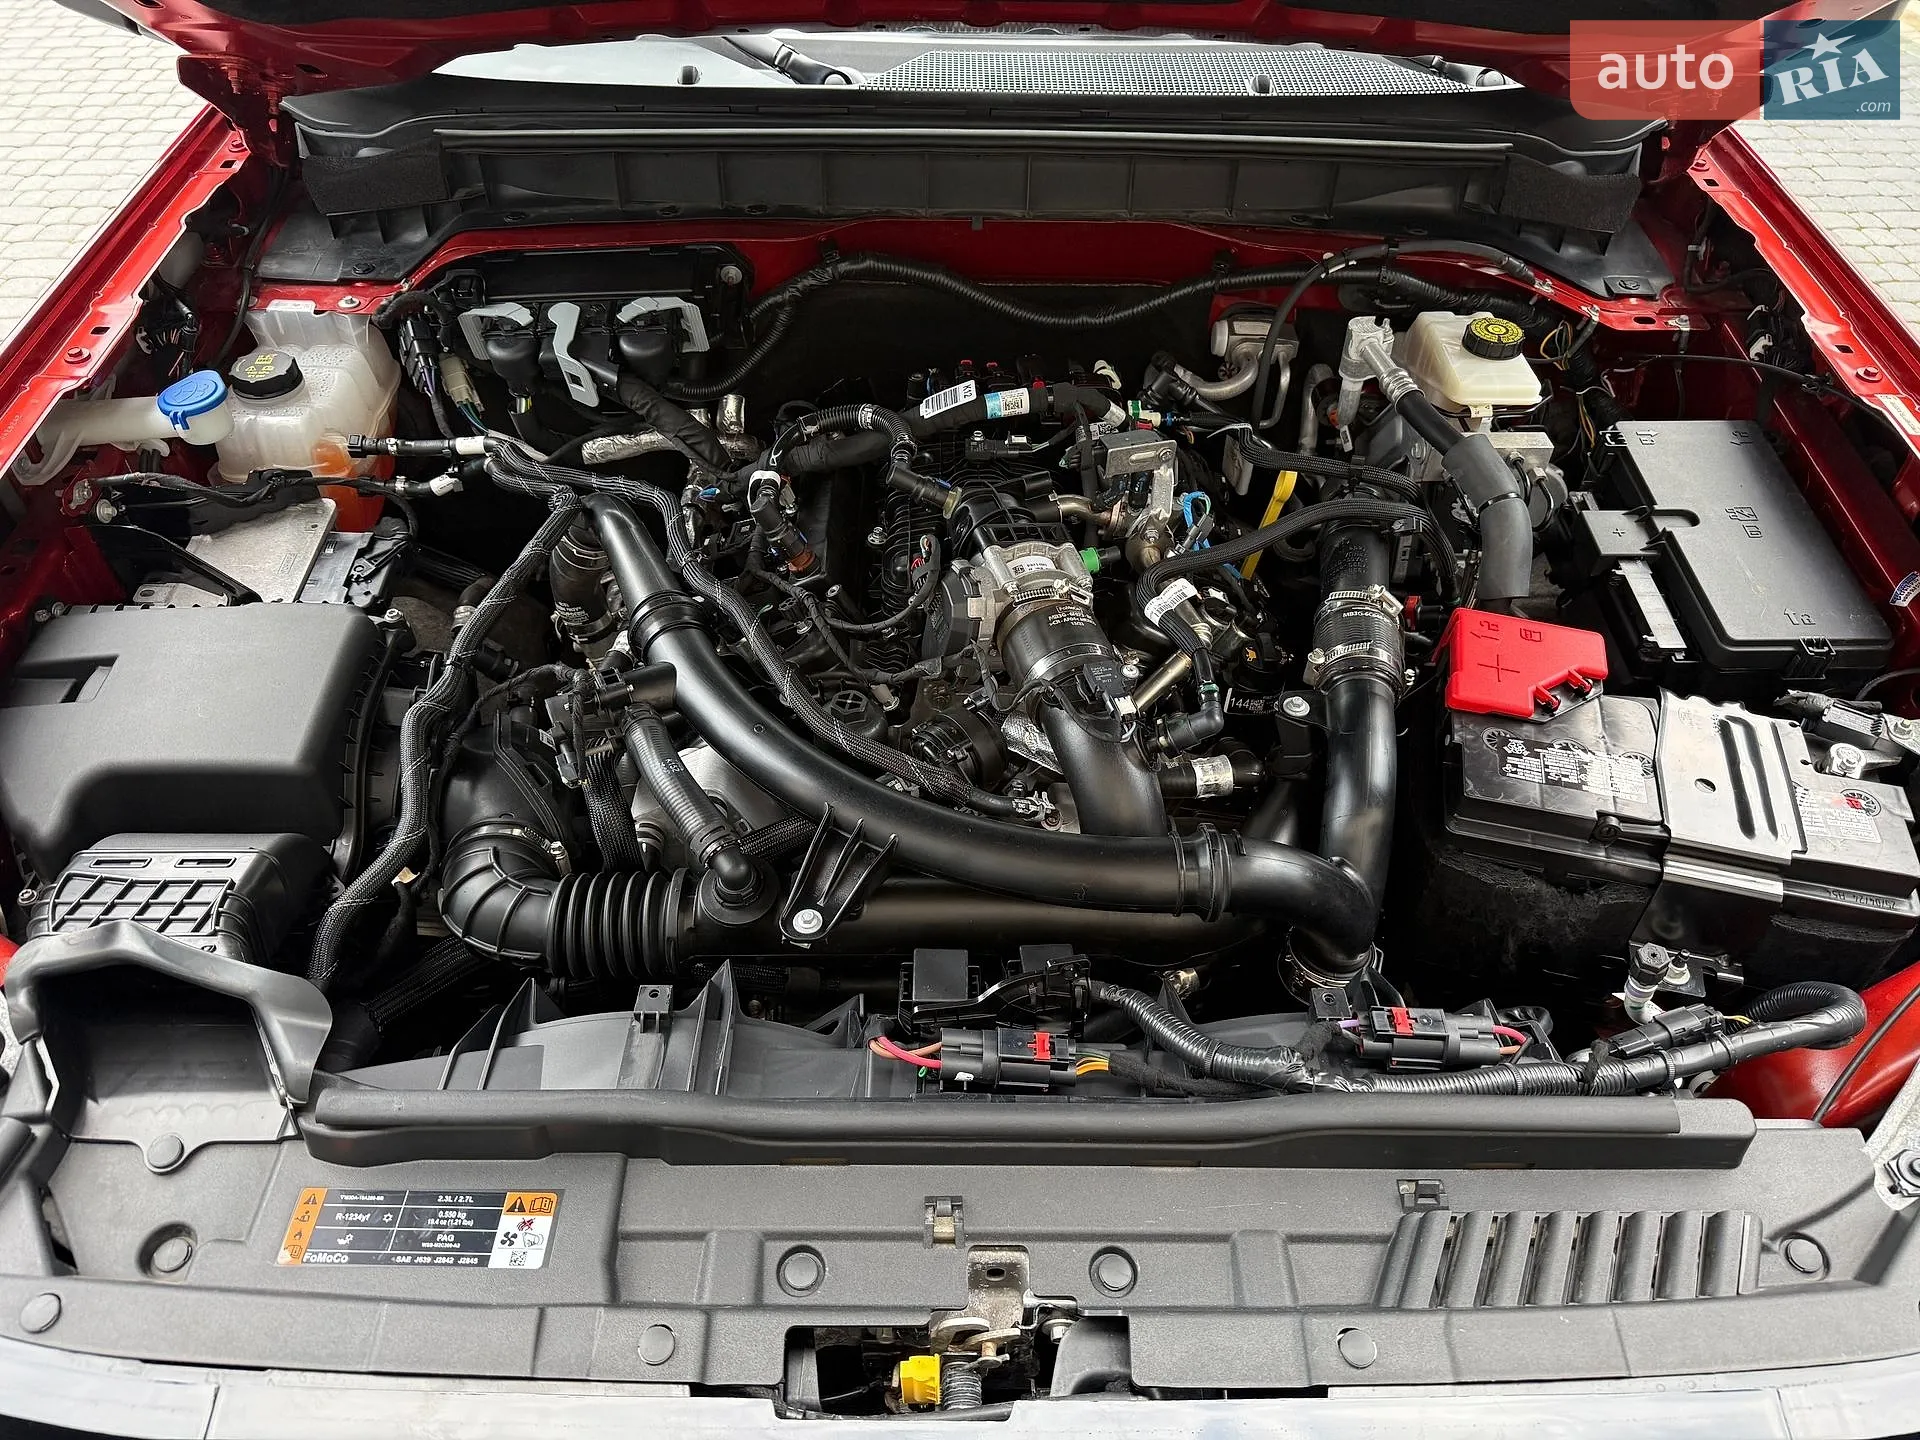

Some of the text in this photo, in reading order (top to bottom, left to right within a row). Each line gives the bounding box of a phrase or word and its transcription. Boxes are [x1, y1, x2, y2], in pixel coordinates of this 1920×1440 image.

[962, 383, 972, 399] K12
[1230, 697, 1250, 709] 144
[335, 1212, 371, 1222] R-1234yf
[438, 1210, 467, 1220] 0.550 kg
[436, 1233, 455, 1242] PAG
[302, 1252, 349, 1264] FoMoCo
[395, 1255, 412, 1264] SAE
[413, 1256, 431, 1264] J639
[433, 1256, 454, 1264] J2842
